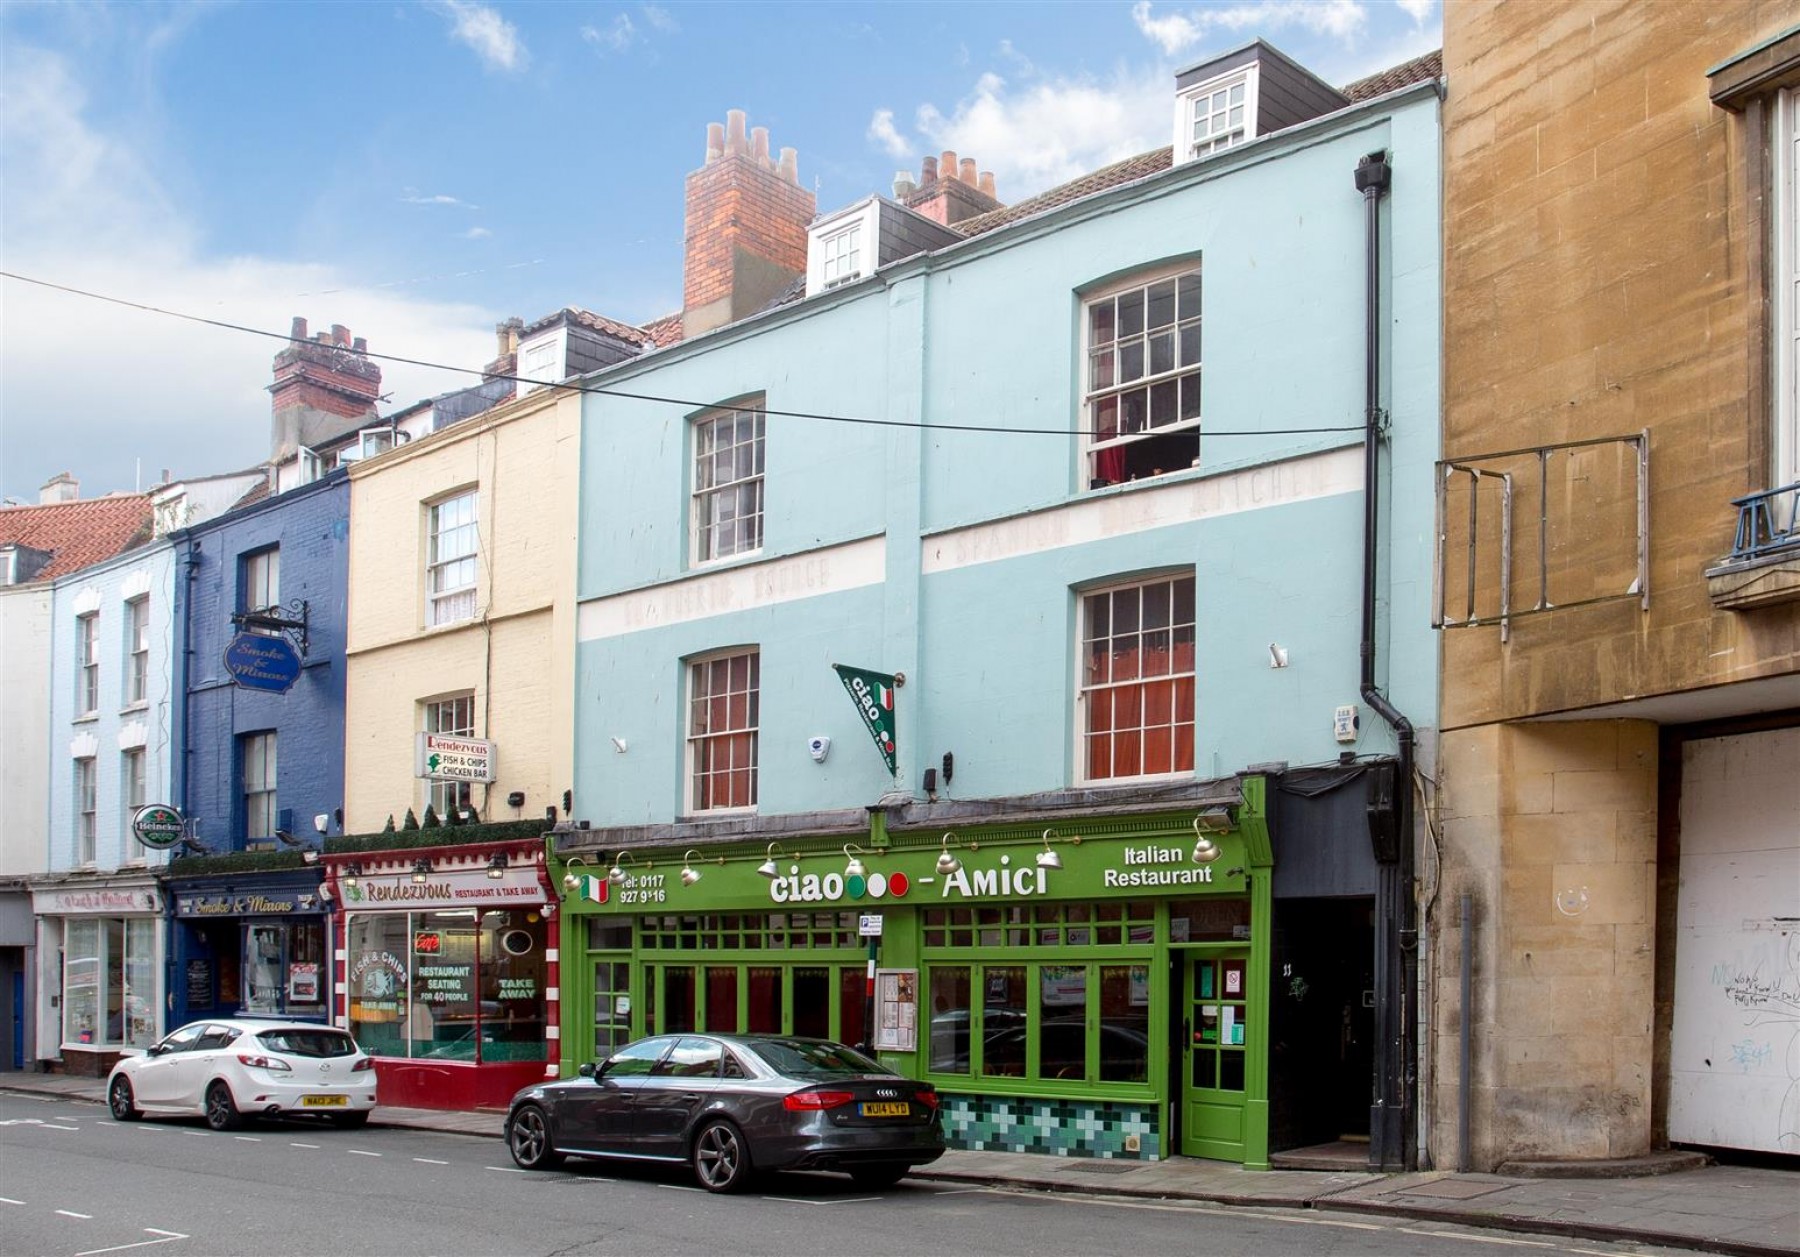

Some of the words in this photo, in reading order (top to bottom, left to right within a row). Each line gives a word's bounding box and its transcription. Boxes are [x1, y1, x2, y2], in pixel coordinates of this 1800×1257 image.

[237, 643, 285, 660] Smoke
[852, 677, 880, 720] ciao
[428, 736, 488, 754] Rendezvous
[444, 756, 459, 765] FISH
[460, 757, 466, 766] &
[467, 758, 487, 768] CHIPS
[443, 766, 472, 777] CHICKEN
[474, 769, 488, 778] BAR
[1125, 846, 1183, 865] Italian
[640, 875, 665, 888] 0117
[770, 865, 844, 902] ciao
[1104, 866, 1212, 887] Restaurant
[367, 877, 452, 901] Rendezvous
[455, 889, 495, 898] RESTAURANT
[502, 887, 519, 897] TAKE
[521, 886, 540, 896] AWAY
[620, 890, 638, 904] 927
[195, 896, 230, 913] Smoke
[233, 901, 243, 912] &
[351, 955, 369, 982] FISH
[373, 952, 379, 961] &
[381, 952, 407, 984] CHIPS
[418, 967, 470, 977] RESTAURANT
[427, 979, 462, 990] SEATING
[499, 979, 535, 988] TAKE
[421, 993, 433, 1001] FOR
[433, 991, 445, 1002] 40
[445, 993, 468, 1002] PEOPLE
[498, 989, 536, 999] AWAY
[361, 1001, 377, 1010] TAKE
[378, 1001, 397, 1010] AWAY
